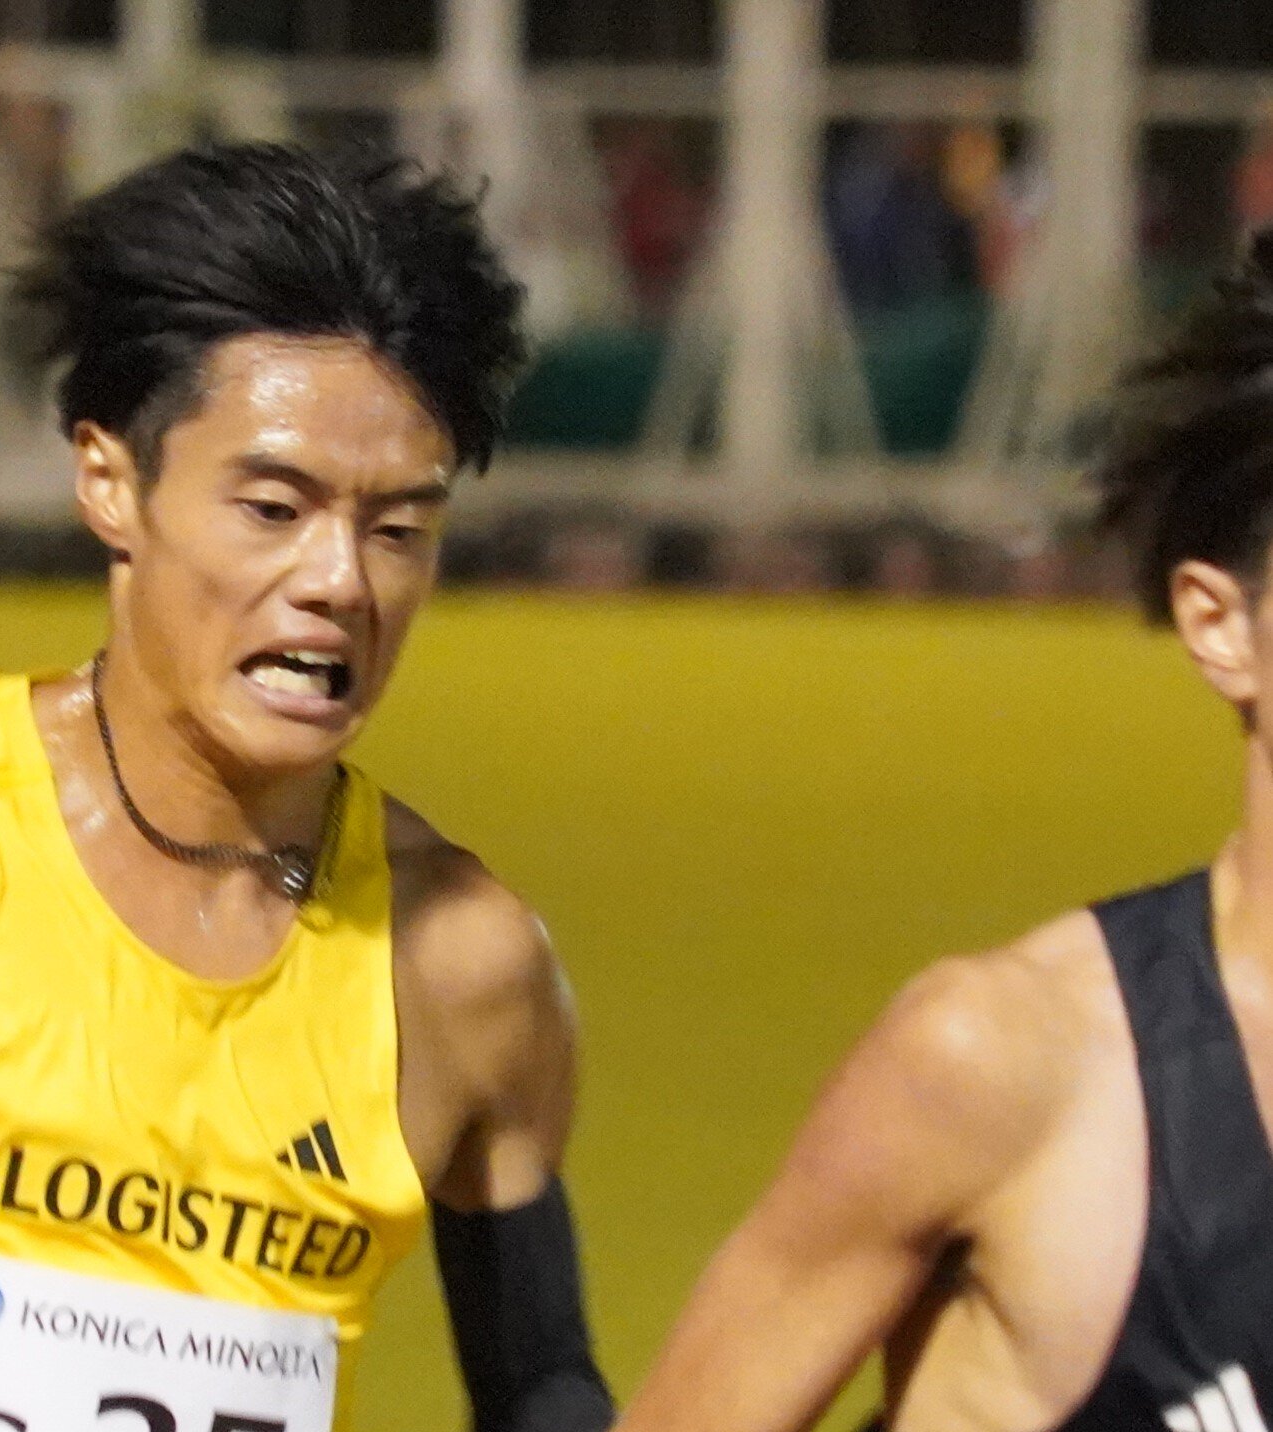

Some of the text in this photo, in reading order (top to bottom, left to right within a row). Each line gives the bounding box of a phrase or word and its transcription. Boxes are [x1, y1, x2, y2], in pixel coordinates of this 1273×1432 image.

[1, 1145, 371, 1279] LOGISTEED
[21, 1298, 321, 1383] KONICA MINOLTA
